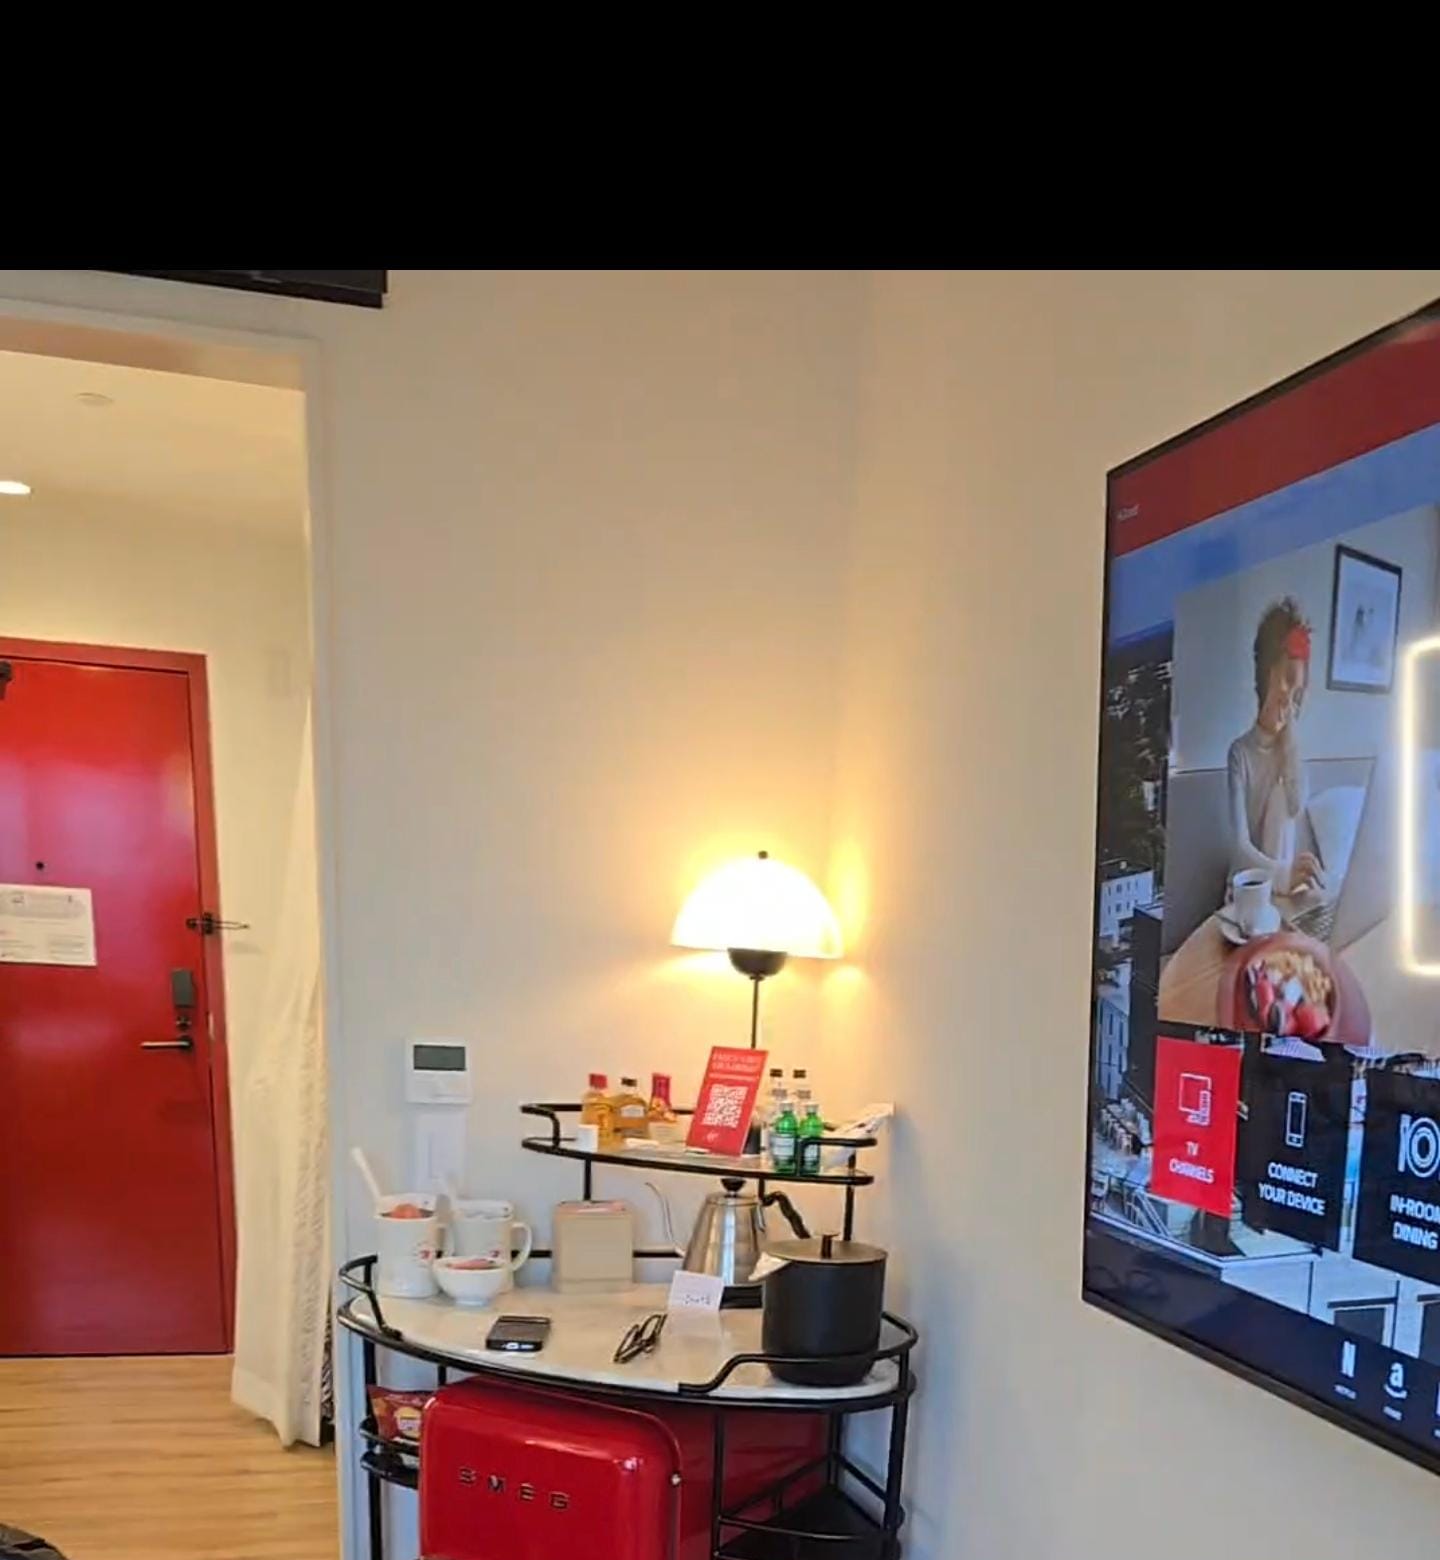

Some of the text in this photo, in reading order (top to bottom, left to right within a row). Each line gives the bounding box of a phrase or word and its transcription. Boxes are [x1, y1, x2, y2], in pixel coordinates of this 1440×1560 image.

[1185, 1141, 1199, 1156] TV
[1169, 1158, 1215, 1184] CHANNELS
[1268, 1162, 1319, 1188] CONNECT
[1258, 1182, 1327, 1216] YOUR DEVICE
[1393, 1221, 1439, 1250] DINING
